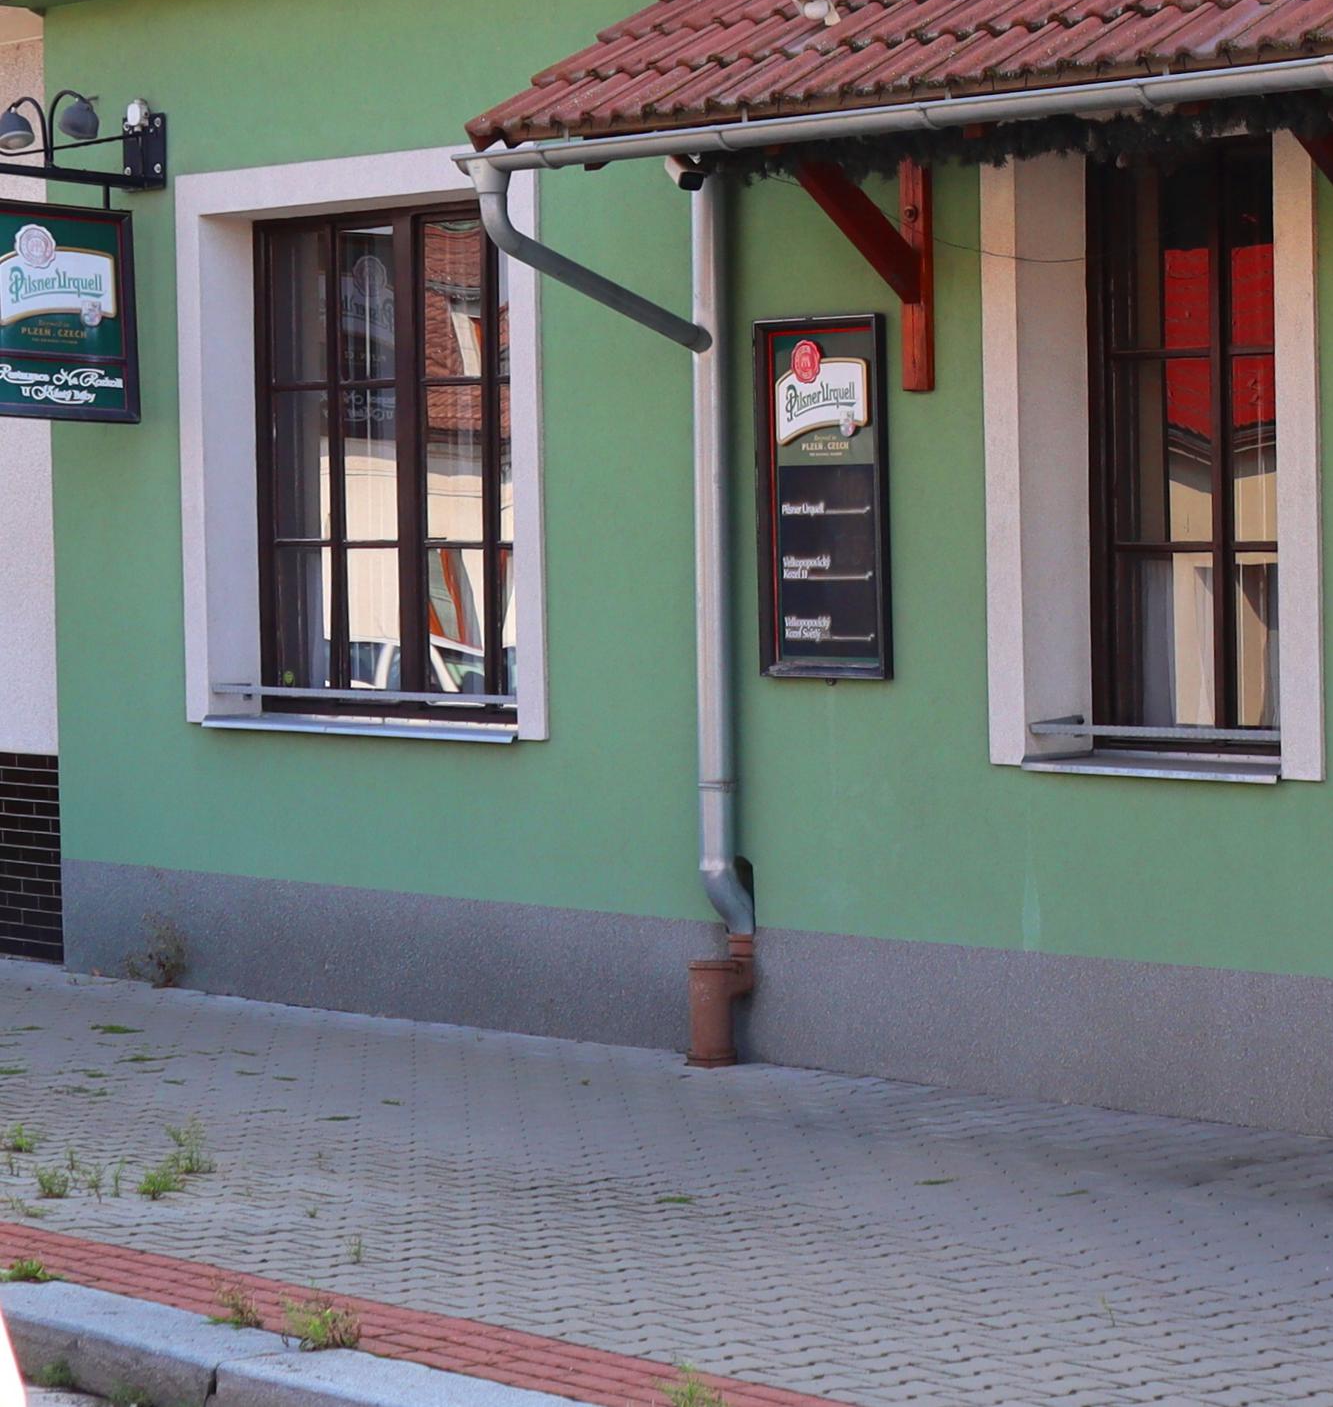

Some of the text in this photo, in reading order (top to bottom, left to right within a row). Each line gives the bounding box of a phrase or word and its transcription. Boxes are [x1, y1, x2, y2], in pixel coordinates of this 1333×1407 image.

[9, 266, 103, 304] Pilsner Urquell
[786, 381, 855, 422] Pilsner Urquell
